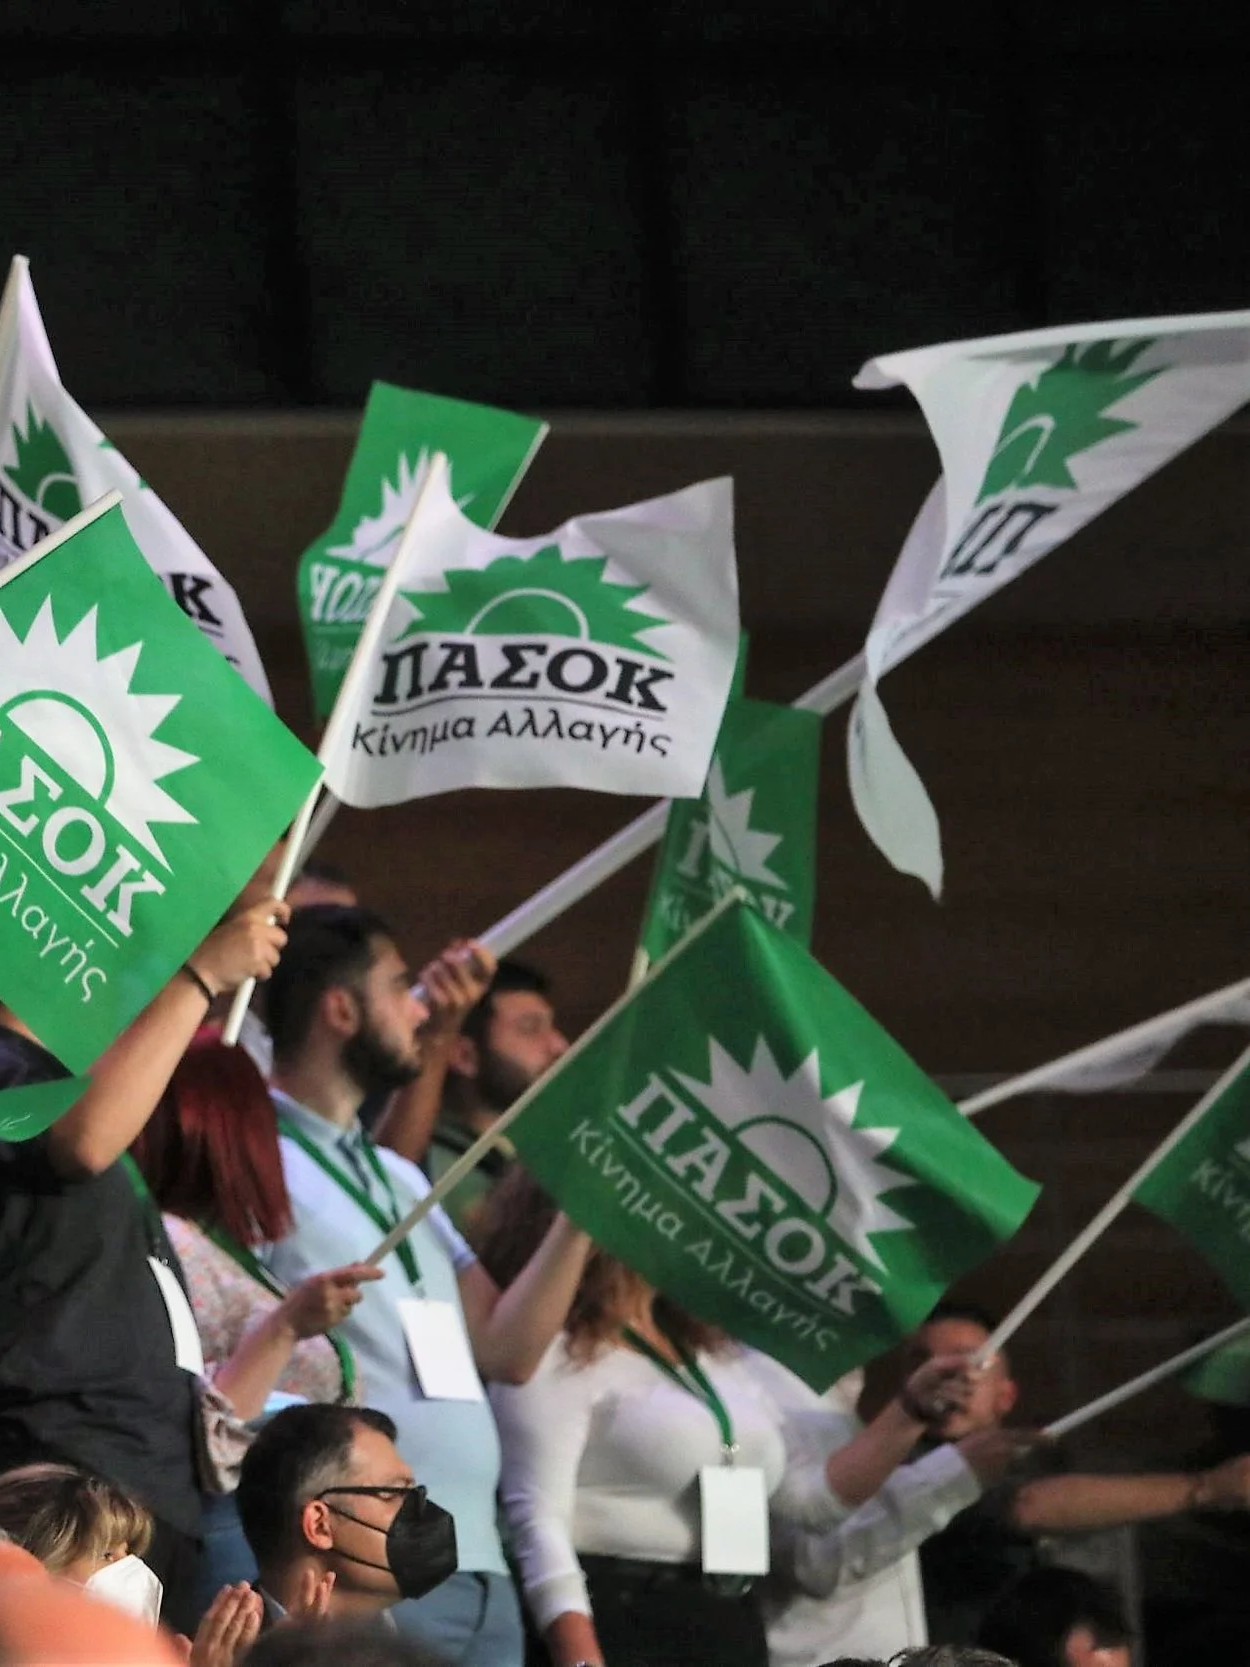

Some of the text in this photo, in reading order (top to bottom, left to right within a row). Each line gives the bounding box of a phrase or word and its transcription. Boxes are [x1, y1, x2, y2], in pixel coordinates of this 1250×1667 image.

[352, 708, 673, 757] Κίνημα Αλλαγής
[373, 642, 675, 713] ΠΑΣΟΚ
[568, 1118, 840, 1351] Κίνημα Αλλαγής
[616, 1072, 884, 1317] ΠΑΣΟΚ
